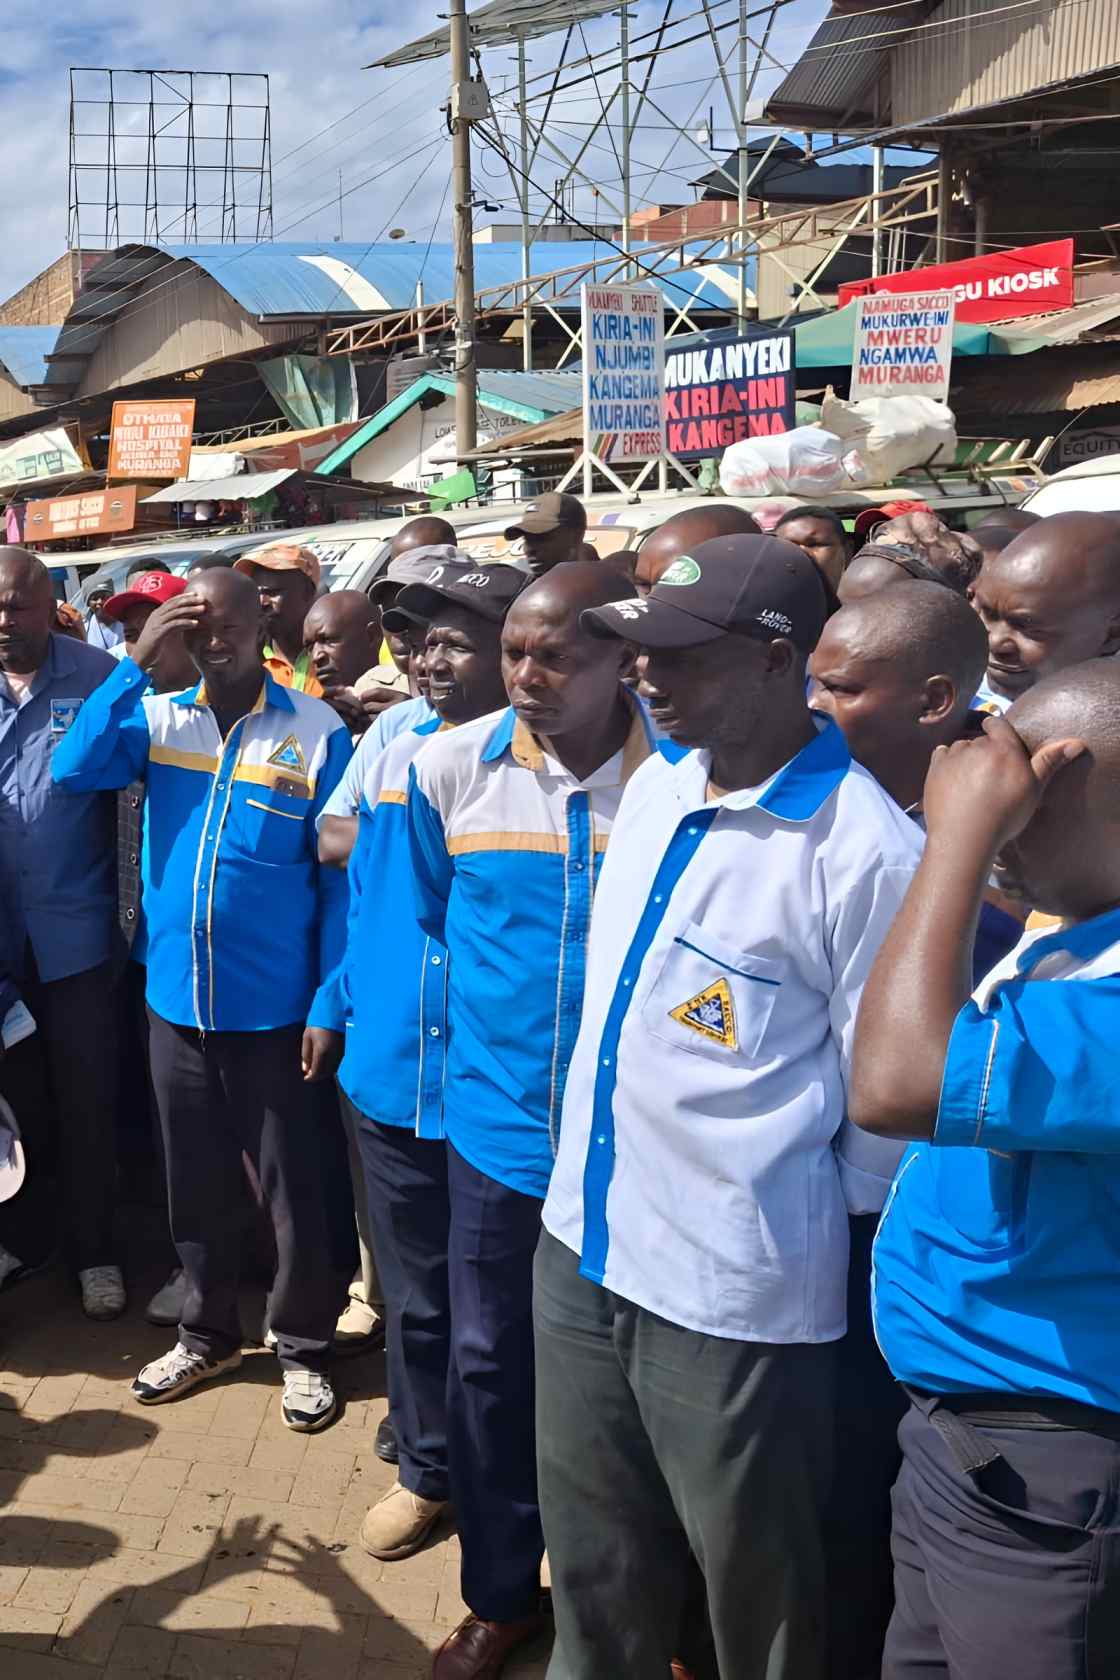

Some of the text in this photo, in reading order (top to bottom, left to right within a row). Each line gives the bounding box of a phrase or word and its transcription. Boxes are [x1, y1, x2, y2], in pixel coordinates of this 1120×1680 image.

[987, 265, 1060, 297] KIOSK
[863, 297, 914, 314] NAMUGA
[592, 314, 656, 341] KIRIA-INI
[867, 328, 942, 346] MWERU
[596, 345, 655, 370] NJUMBI
[665, 336, 791, 388] MUKANYEKI
[859, 346, 938, 366] NGAMWA
[589, 374, 660, 401] KANGEMA
[857, 364, 945, 385] MURANGA
[665, 376, 786, 421] KIRIA-INI
[589, 404, 661, 431] MURANGA
[117, 439, 183, 452] HOSPITAL
[623, 432, 662, 457] EXPRESS
[668, 412, 788, 454] KANGEMA
